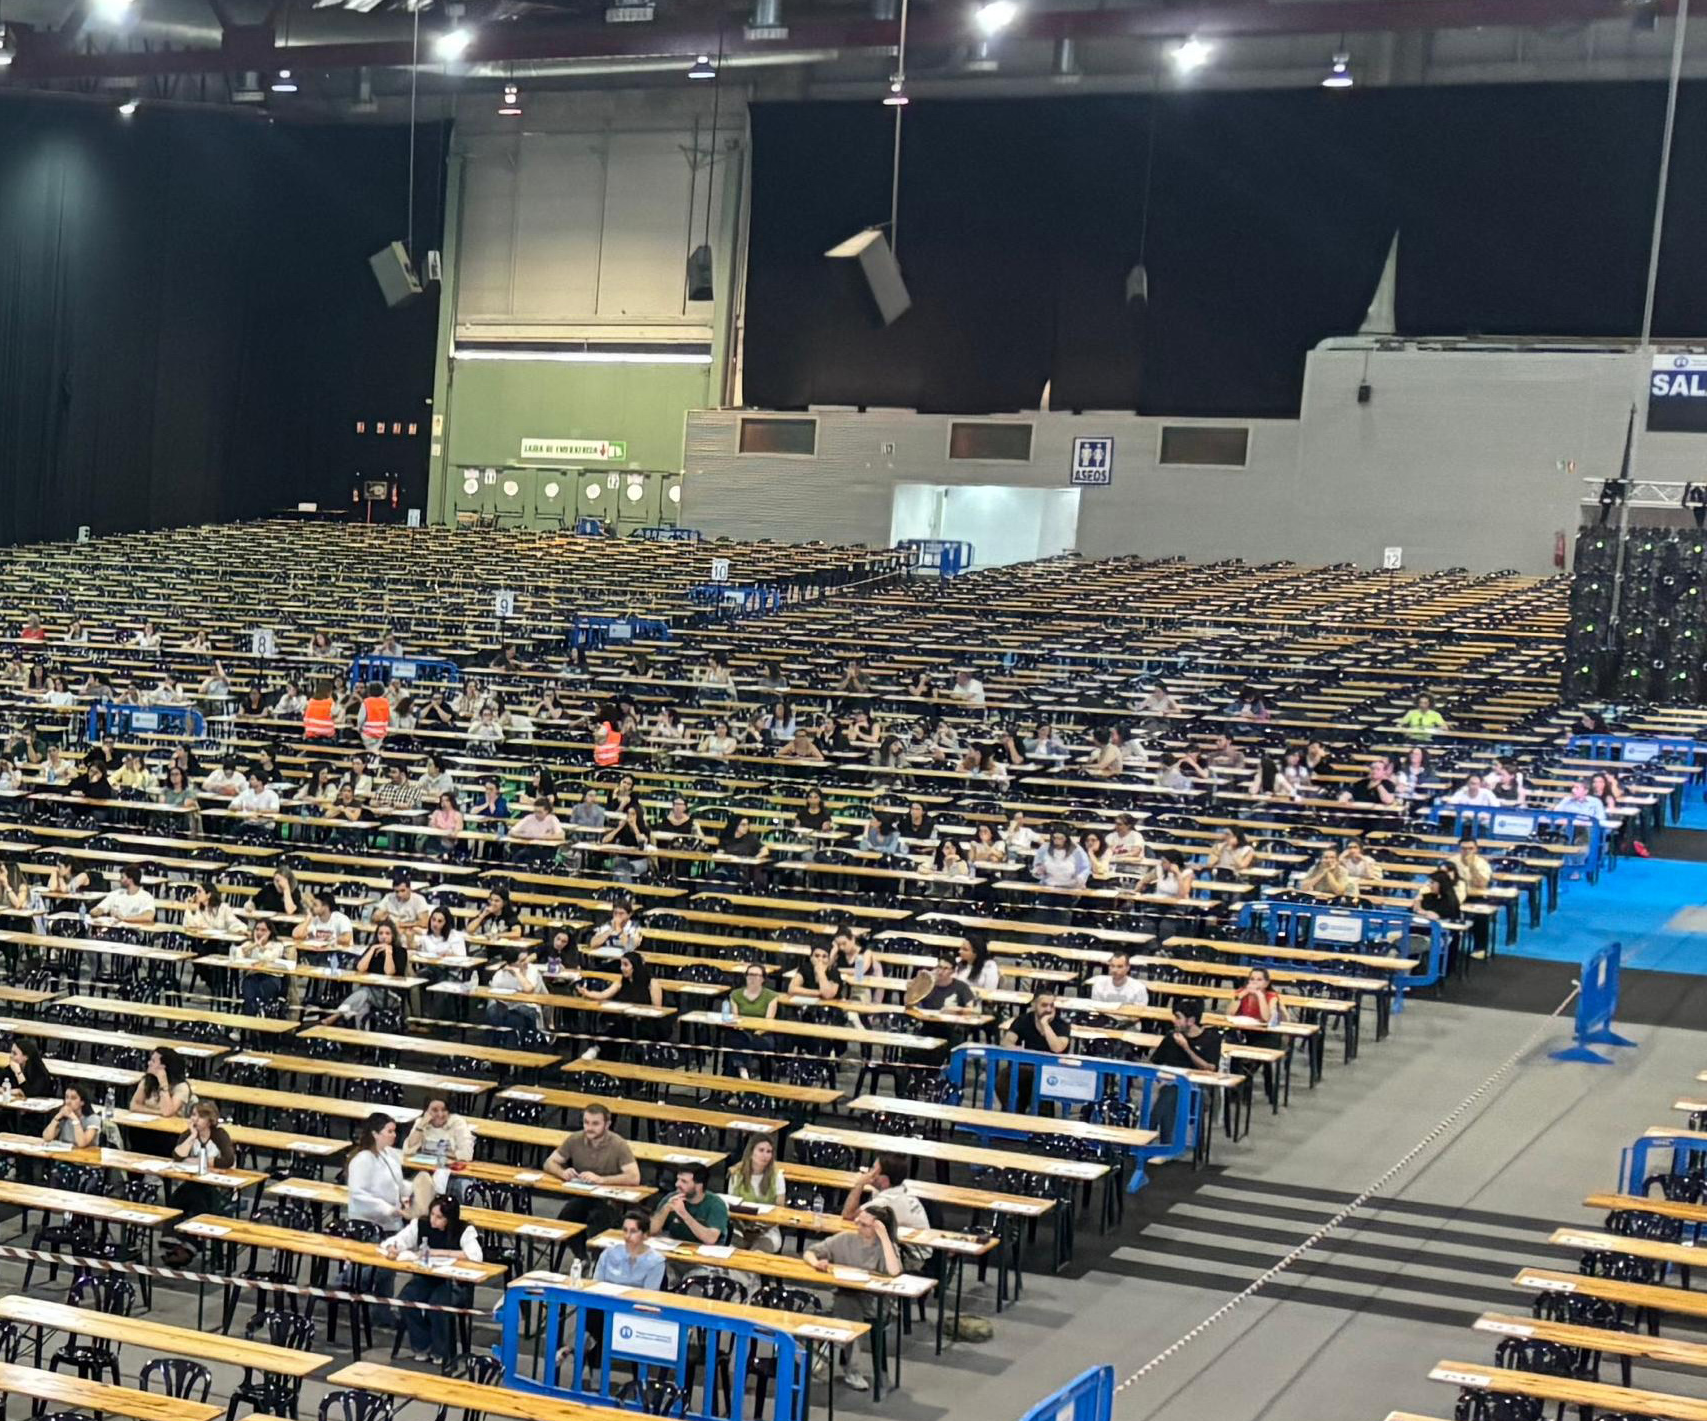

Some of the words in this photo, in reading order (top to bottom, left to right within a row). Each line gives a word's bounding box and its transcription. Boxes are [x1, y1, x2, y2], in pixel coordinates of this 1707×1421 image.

[1652, 374, 1707, 397] SAL
[1074, 470, 1107, 482] ASEOS
[713, 564, 726, 579] 10
[500, 598, 508, 617] 9
[258, 635, 267, 655] 8
